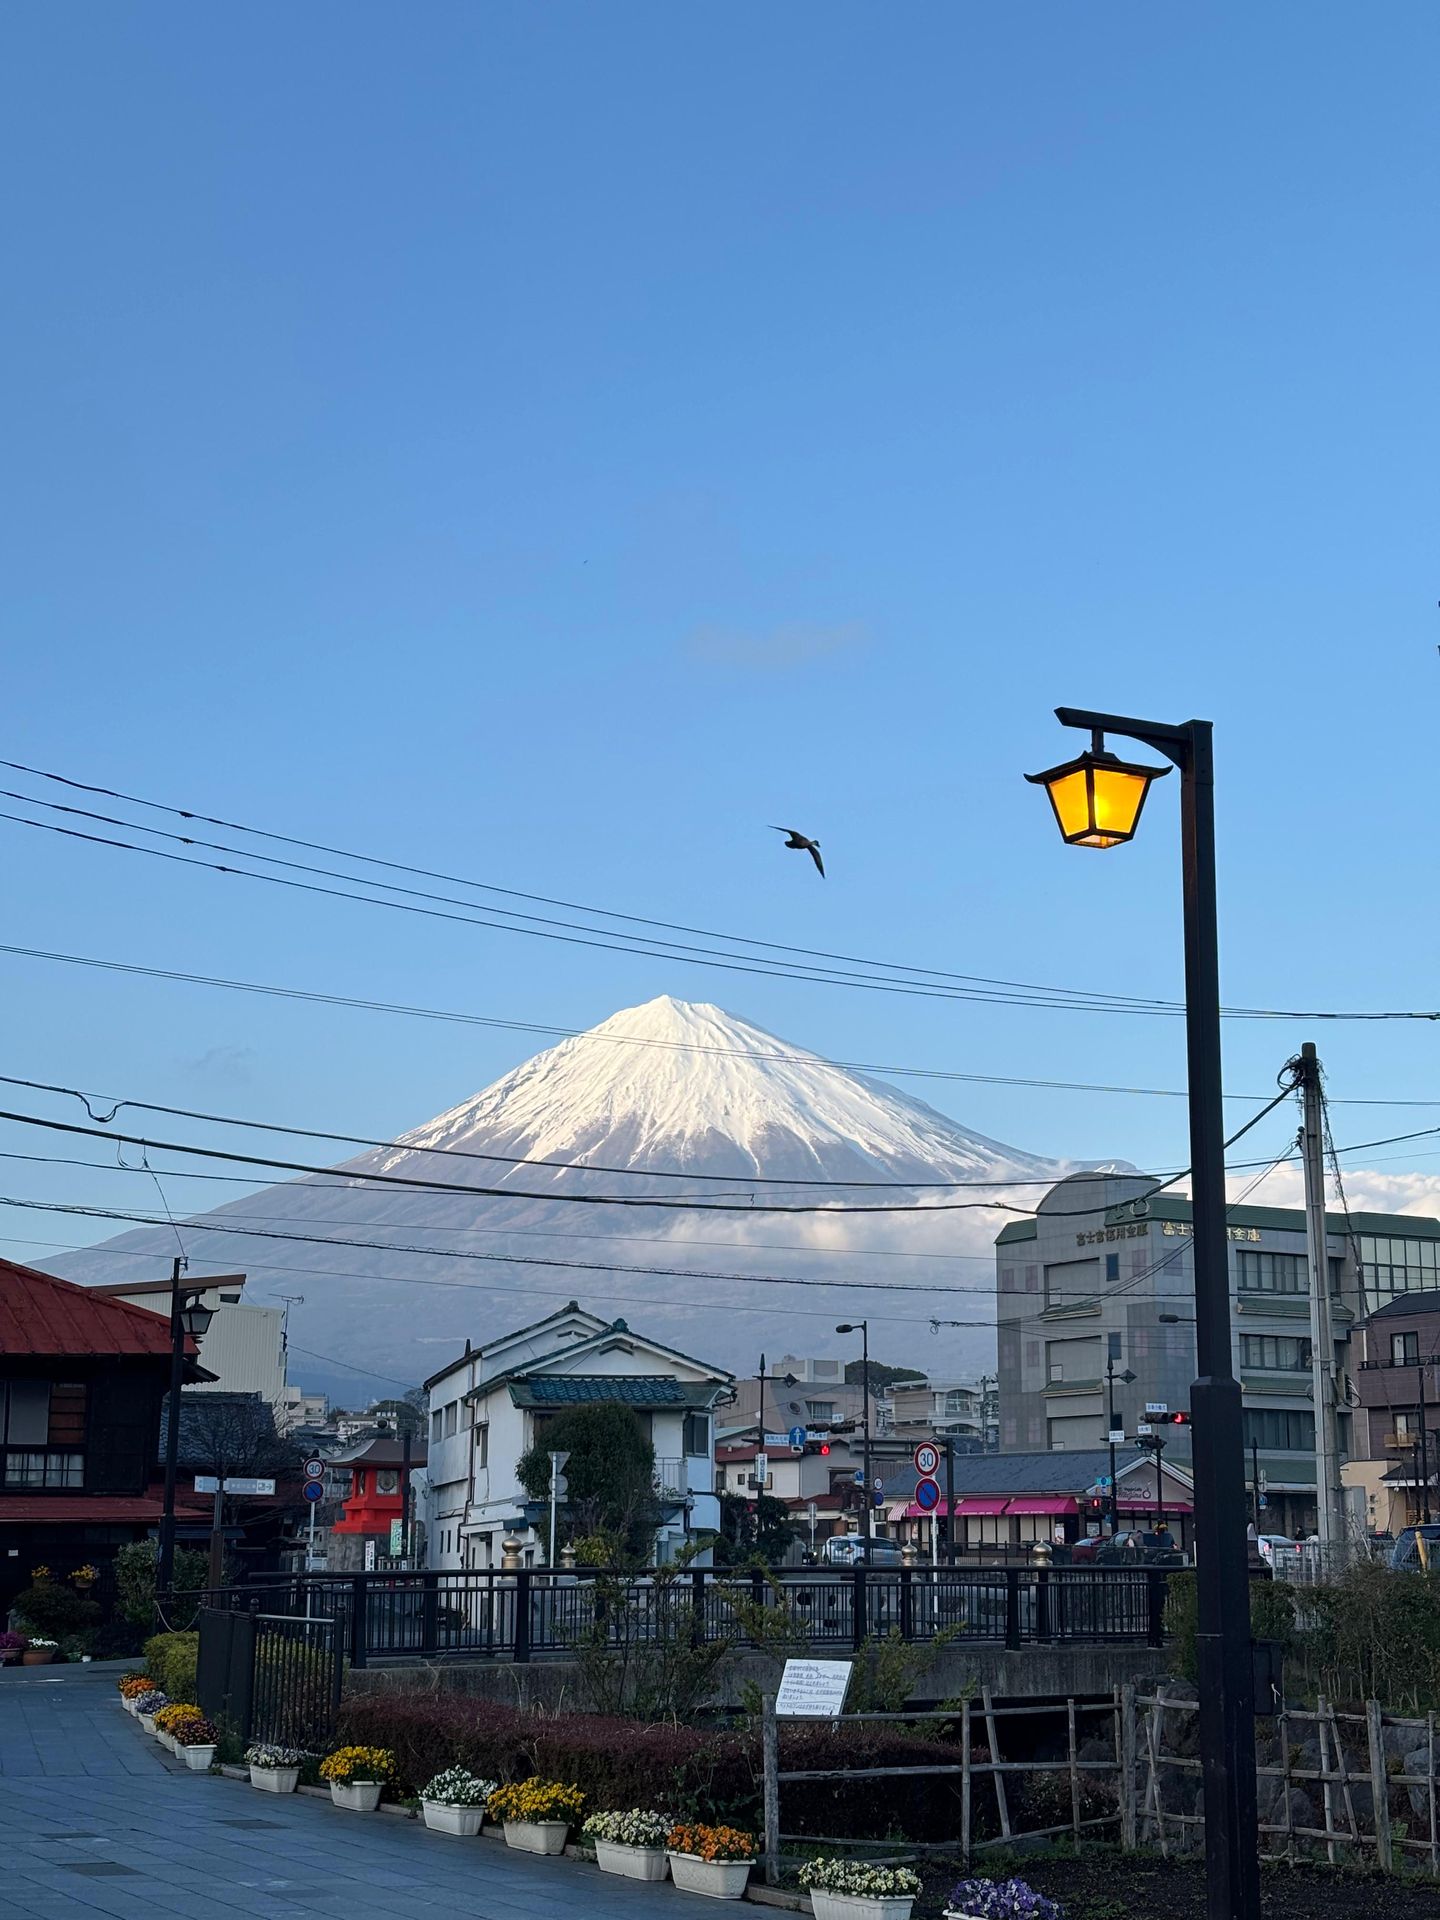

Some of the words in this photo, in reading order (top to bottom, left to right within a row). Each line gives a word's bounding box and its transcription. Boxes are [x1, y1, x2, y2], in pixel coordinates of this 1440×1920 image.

[1076, 1223, 1149, 1246] 富士宮信用金庫
[1162, 1221, 1262, 1243] 富士金庫
[920, 1453, 933, 1467] 30
[308, 1464, 321, 1475] 30
